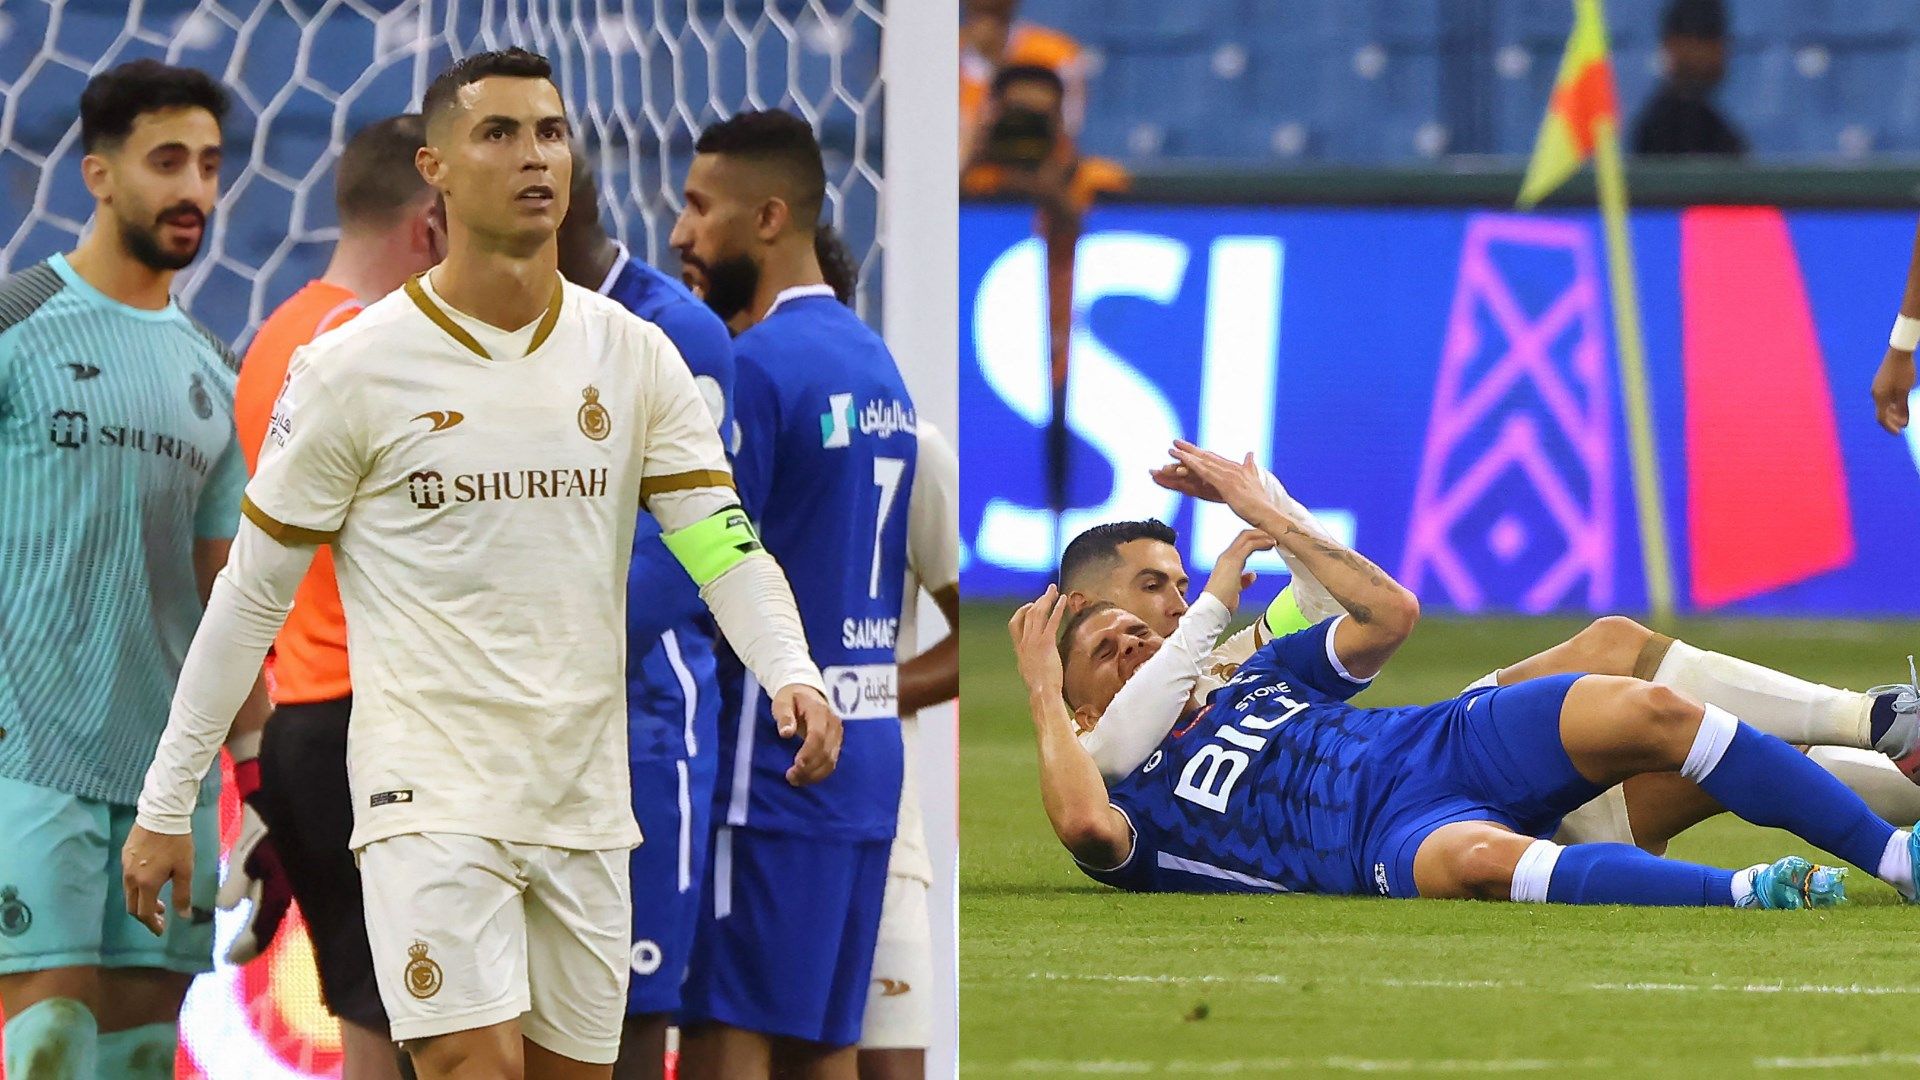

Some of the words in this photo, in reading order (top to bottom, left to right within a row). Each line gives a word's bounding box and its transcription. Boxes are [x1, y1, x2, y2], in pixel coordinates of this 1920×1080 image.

[960, 233, 1356, 572] SL
[454, 468, 608, 503] SHURFAH
[869, 457, 905, 599] 7
[1234, 681, 1292, 713] STORE
